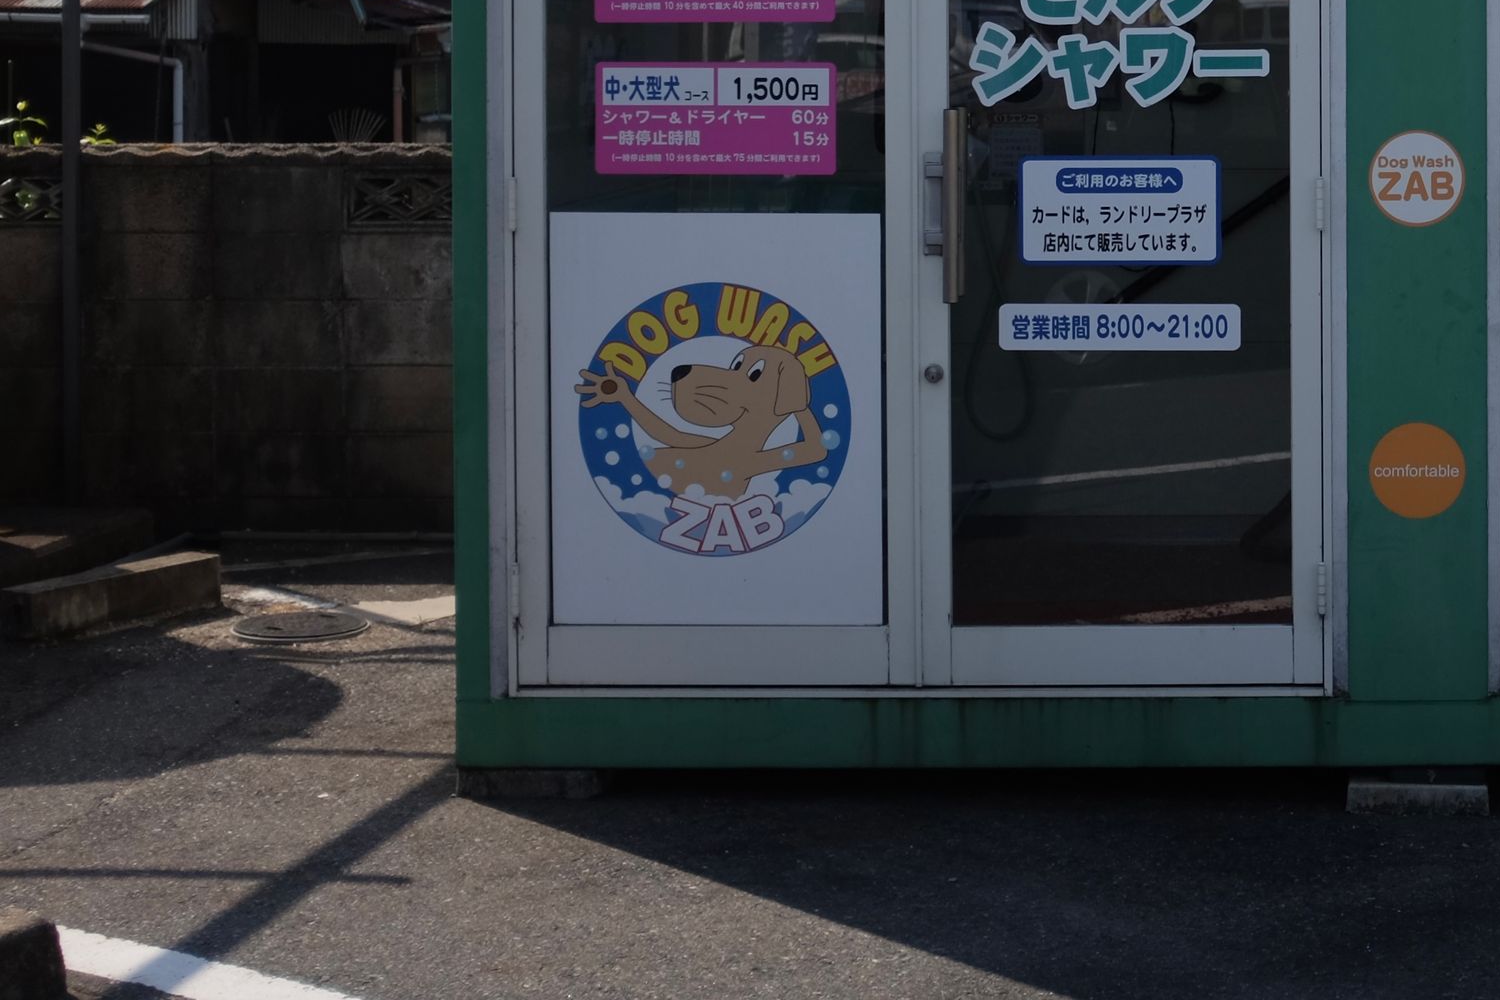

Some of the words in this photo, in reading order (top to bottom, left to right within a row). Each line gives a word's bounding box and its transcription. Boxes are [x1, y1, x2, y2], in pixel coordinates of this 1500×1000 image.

[971, 21, 1270, 109] シャワー
[734, 77, 819, 103] 1,500円
[602, 109, 766, 124] シャワー&ドライヤー
[791, 109, 829, 125] 60分
[602, 130, 700, 146] 一時停止時間
[793, 130, 829, 146] 15分
[1378, 155, 1408, 168] Dog
[1412, 155, 1454, 168] Wash
[1061, 173, 1178, 189] ご利用のお客様へ
[1377, 170, 1454, 201] ZAB
[1043, 231, 1198, 253] 店内にて販売しています。
[599, 290, 700, 382] DOG
[717, 283, 838, 378] WASH
[1011, 314, 1090, 341] 営業時間
[1374, 464, 1460, 478] comfortable
[659, 494, 785, 554] ZAB
